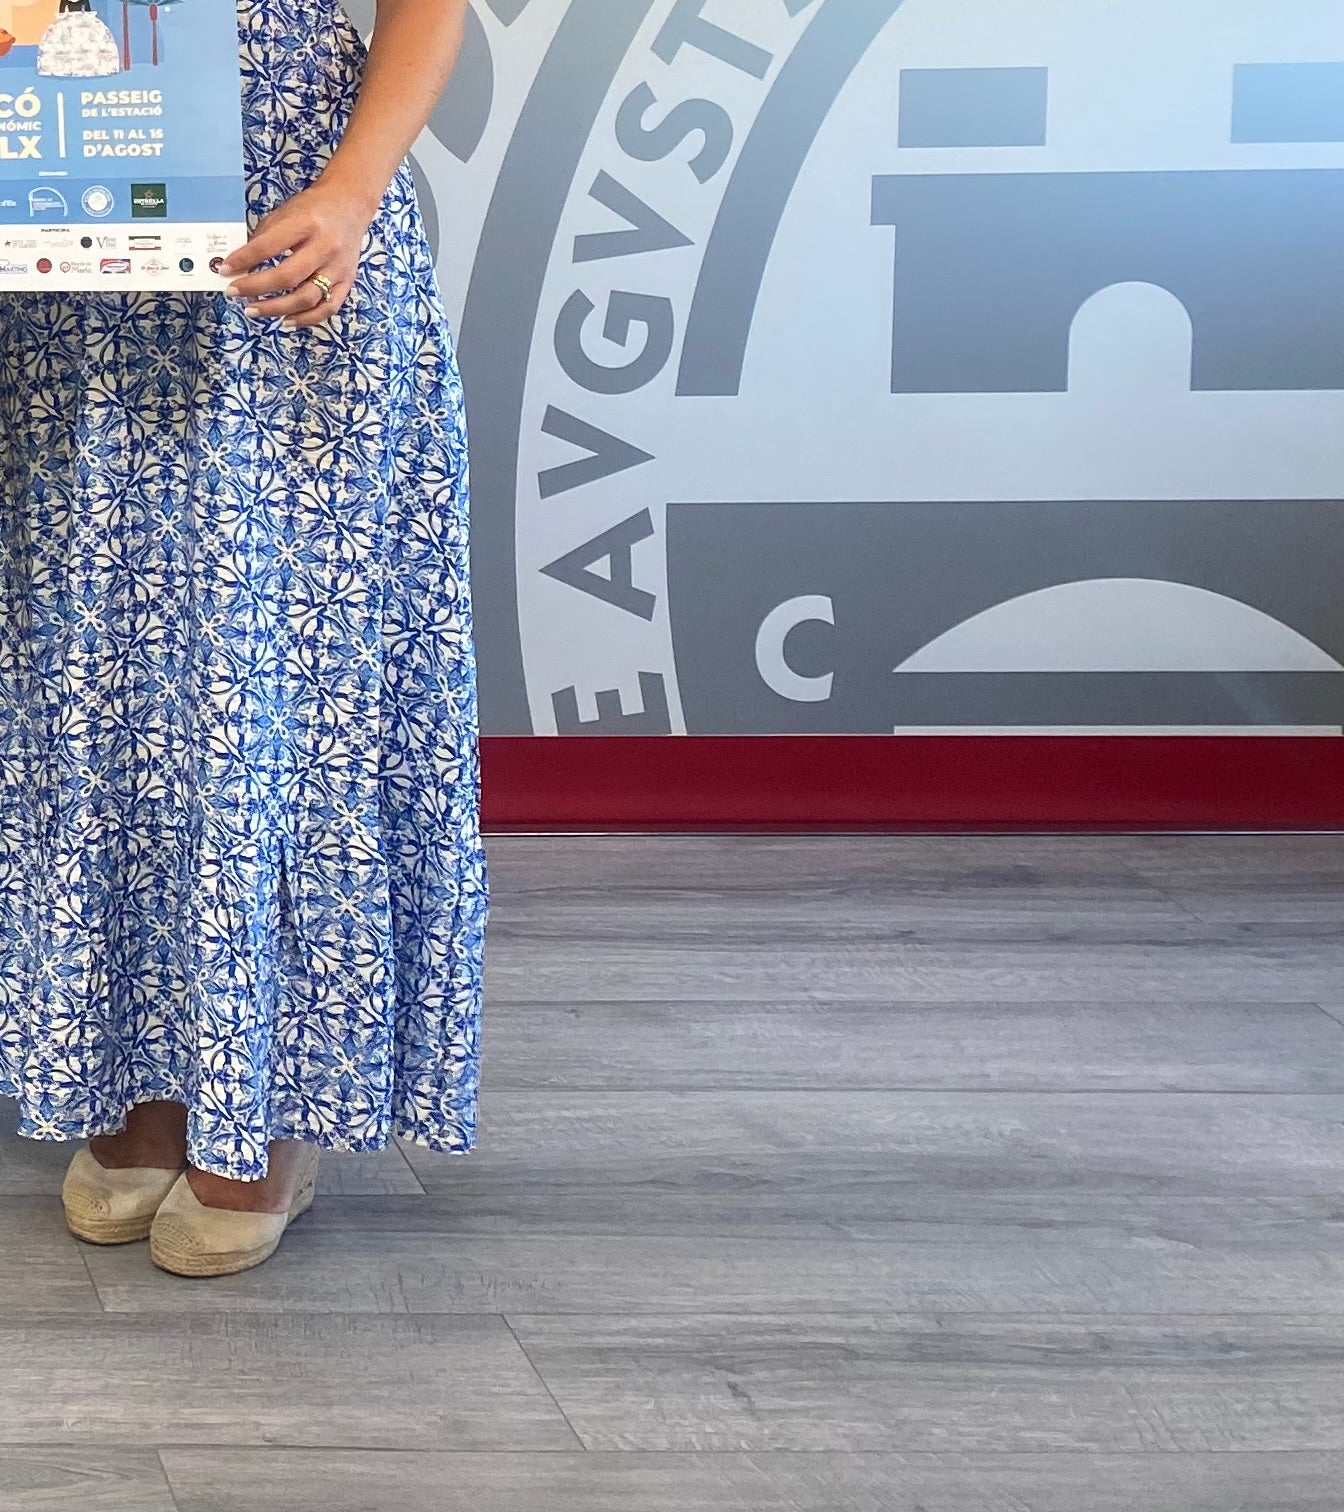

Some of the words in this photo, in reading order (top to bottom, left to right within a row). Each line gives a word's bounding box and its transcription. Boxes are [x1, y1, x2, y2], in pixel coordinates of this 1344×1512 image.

[80, 89, 162, 105] PASSEIG
[81, 108, 98, 118] DE
[101, 104, 163, 117] L'ESTACIÓ
[82, 129, 109, 141] DEL
[113, 129, 125, 140] 11
[127, 128, 146, 140] AL
[150, 128, 164, 140] 15
[83, 143, 164, 158] D'AGOST
[755, 595, 834, 702] C
